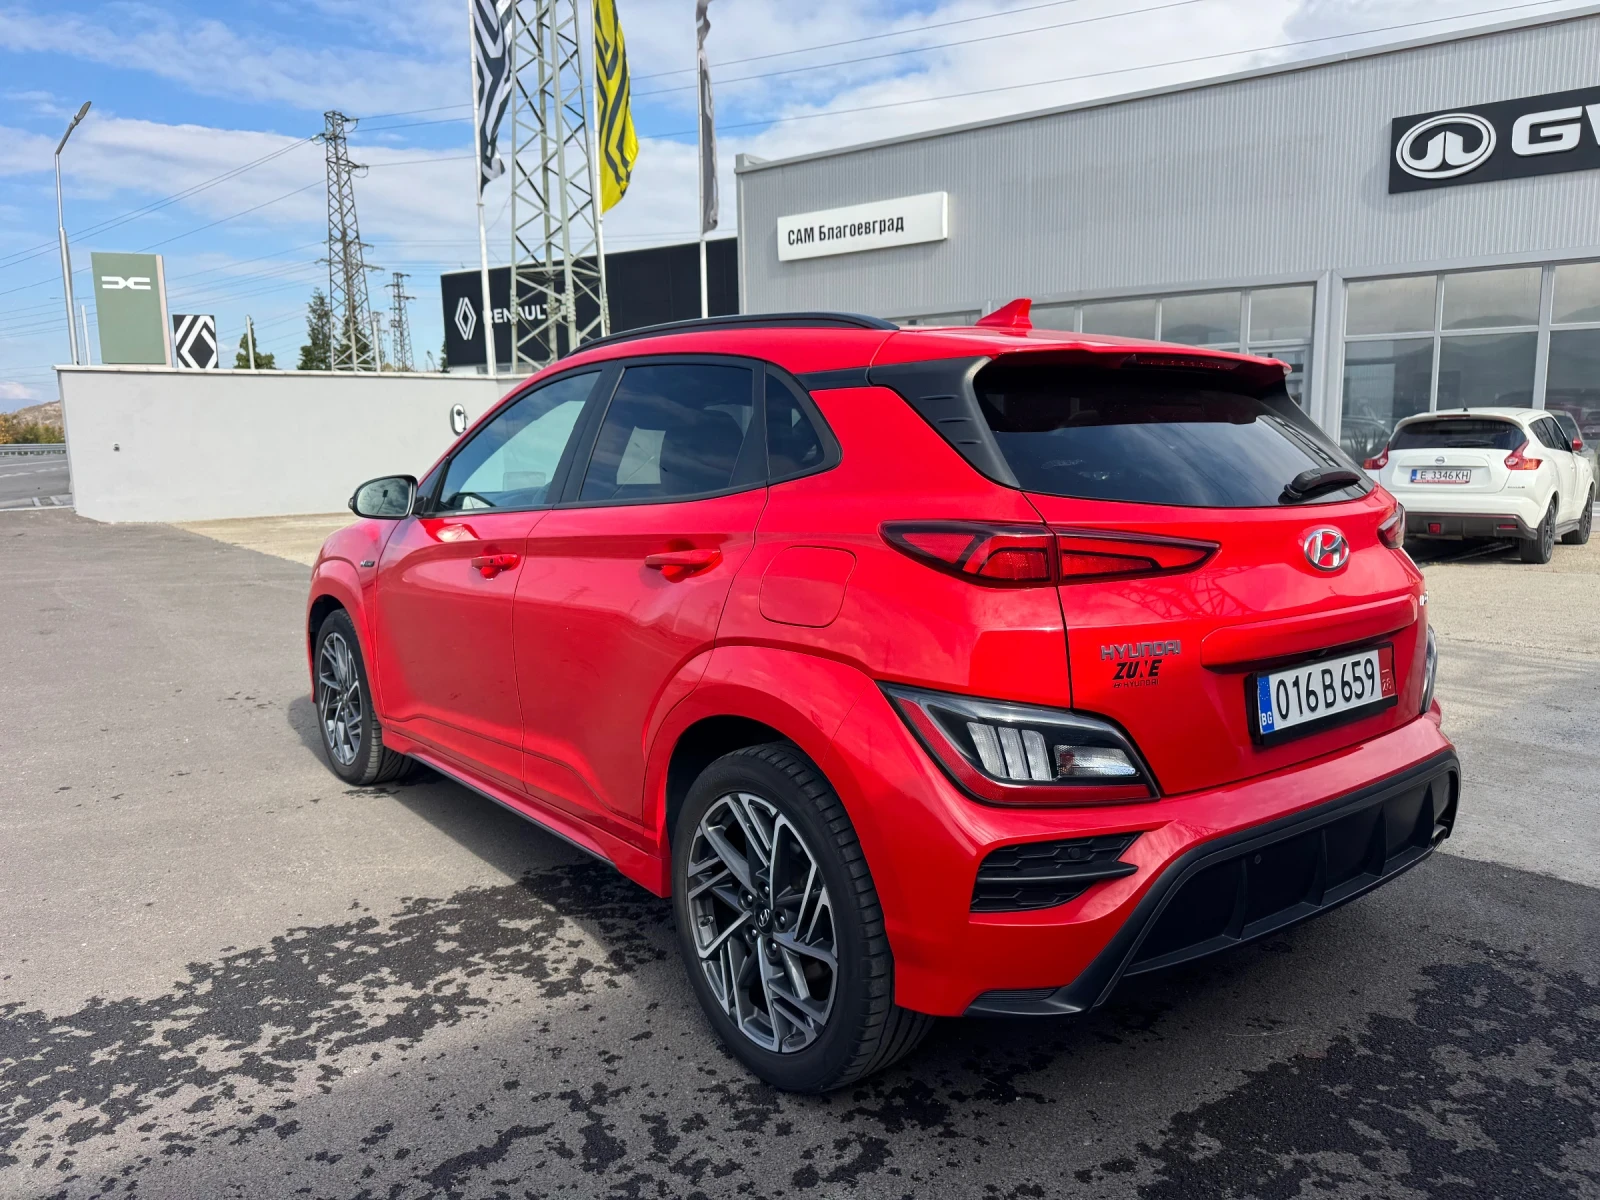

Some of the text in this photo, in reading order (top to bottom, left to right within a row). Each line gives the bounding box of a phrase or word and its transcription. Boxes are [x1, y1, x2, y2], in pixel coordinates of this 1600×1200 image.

[1511, 102, 1600, 157] G
[788, 216, 905, 246] САМ Благоевград
[1431, 470, 1454, 480] 3346
[1101, 639, 1181, 660] HYUNDAI
[1123, 678, 1159, 688] HYUNDAI
[1276, 657, 1375, 720] 016B659
[1261, 711, 1273, 726] BG
